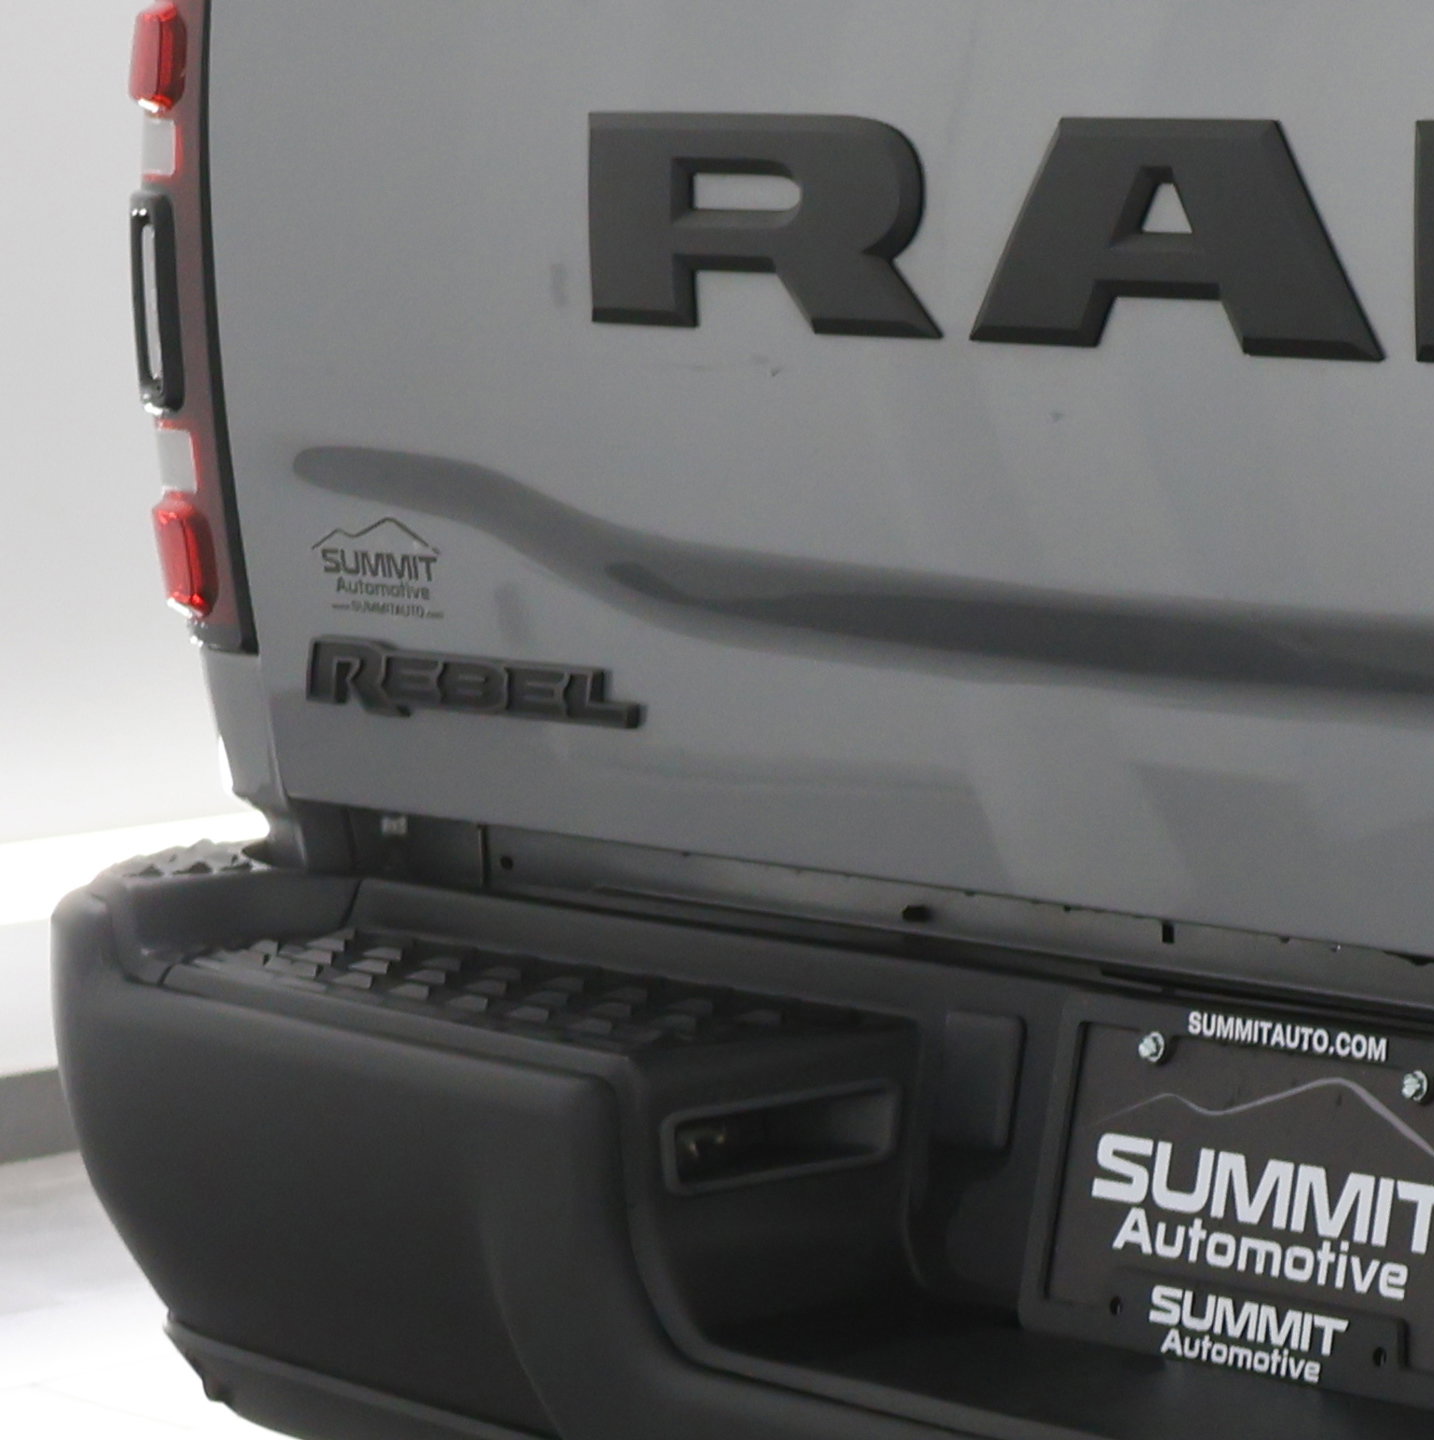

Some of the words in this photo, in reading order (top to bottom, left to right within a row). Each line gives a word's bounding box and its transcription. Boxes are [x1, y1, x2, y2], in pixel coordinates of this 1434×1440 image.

[321, 547, 438, 582] SUMMIT
[335, 576, 431, 601] Automotive
[1187, 1010, 1388, 1063] SUMMITAUTO.COM
[1112, 1206, 1410, 1301] Automotive
[1148, 1284, 1349, 1357] SUMMIT
[1160, 1327, 1322, 1384] Automotive
